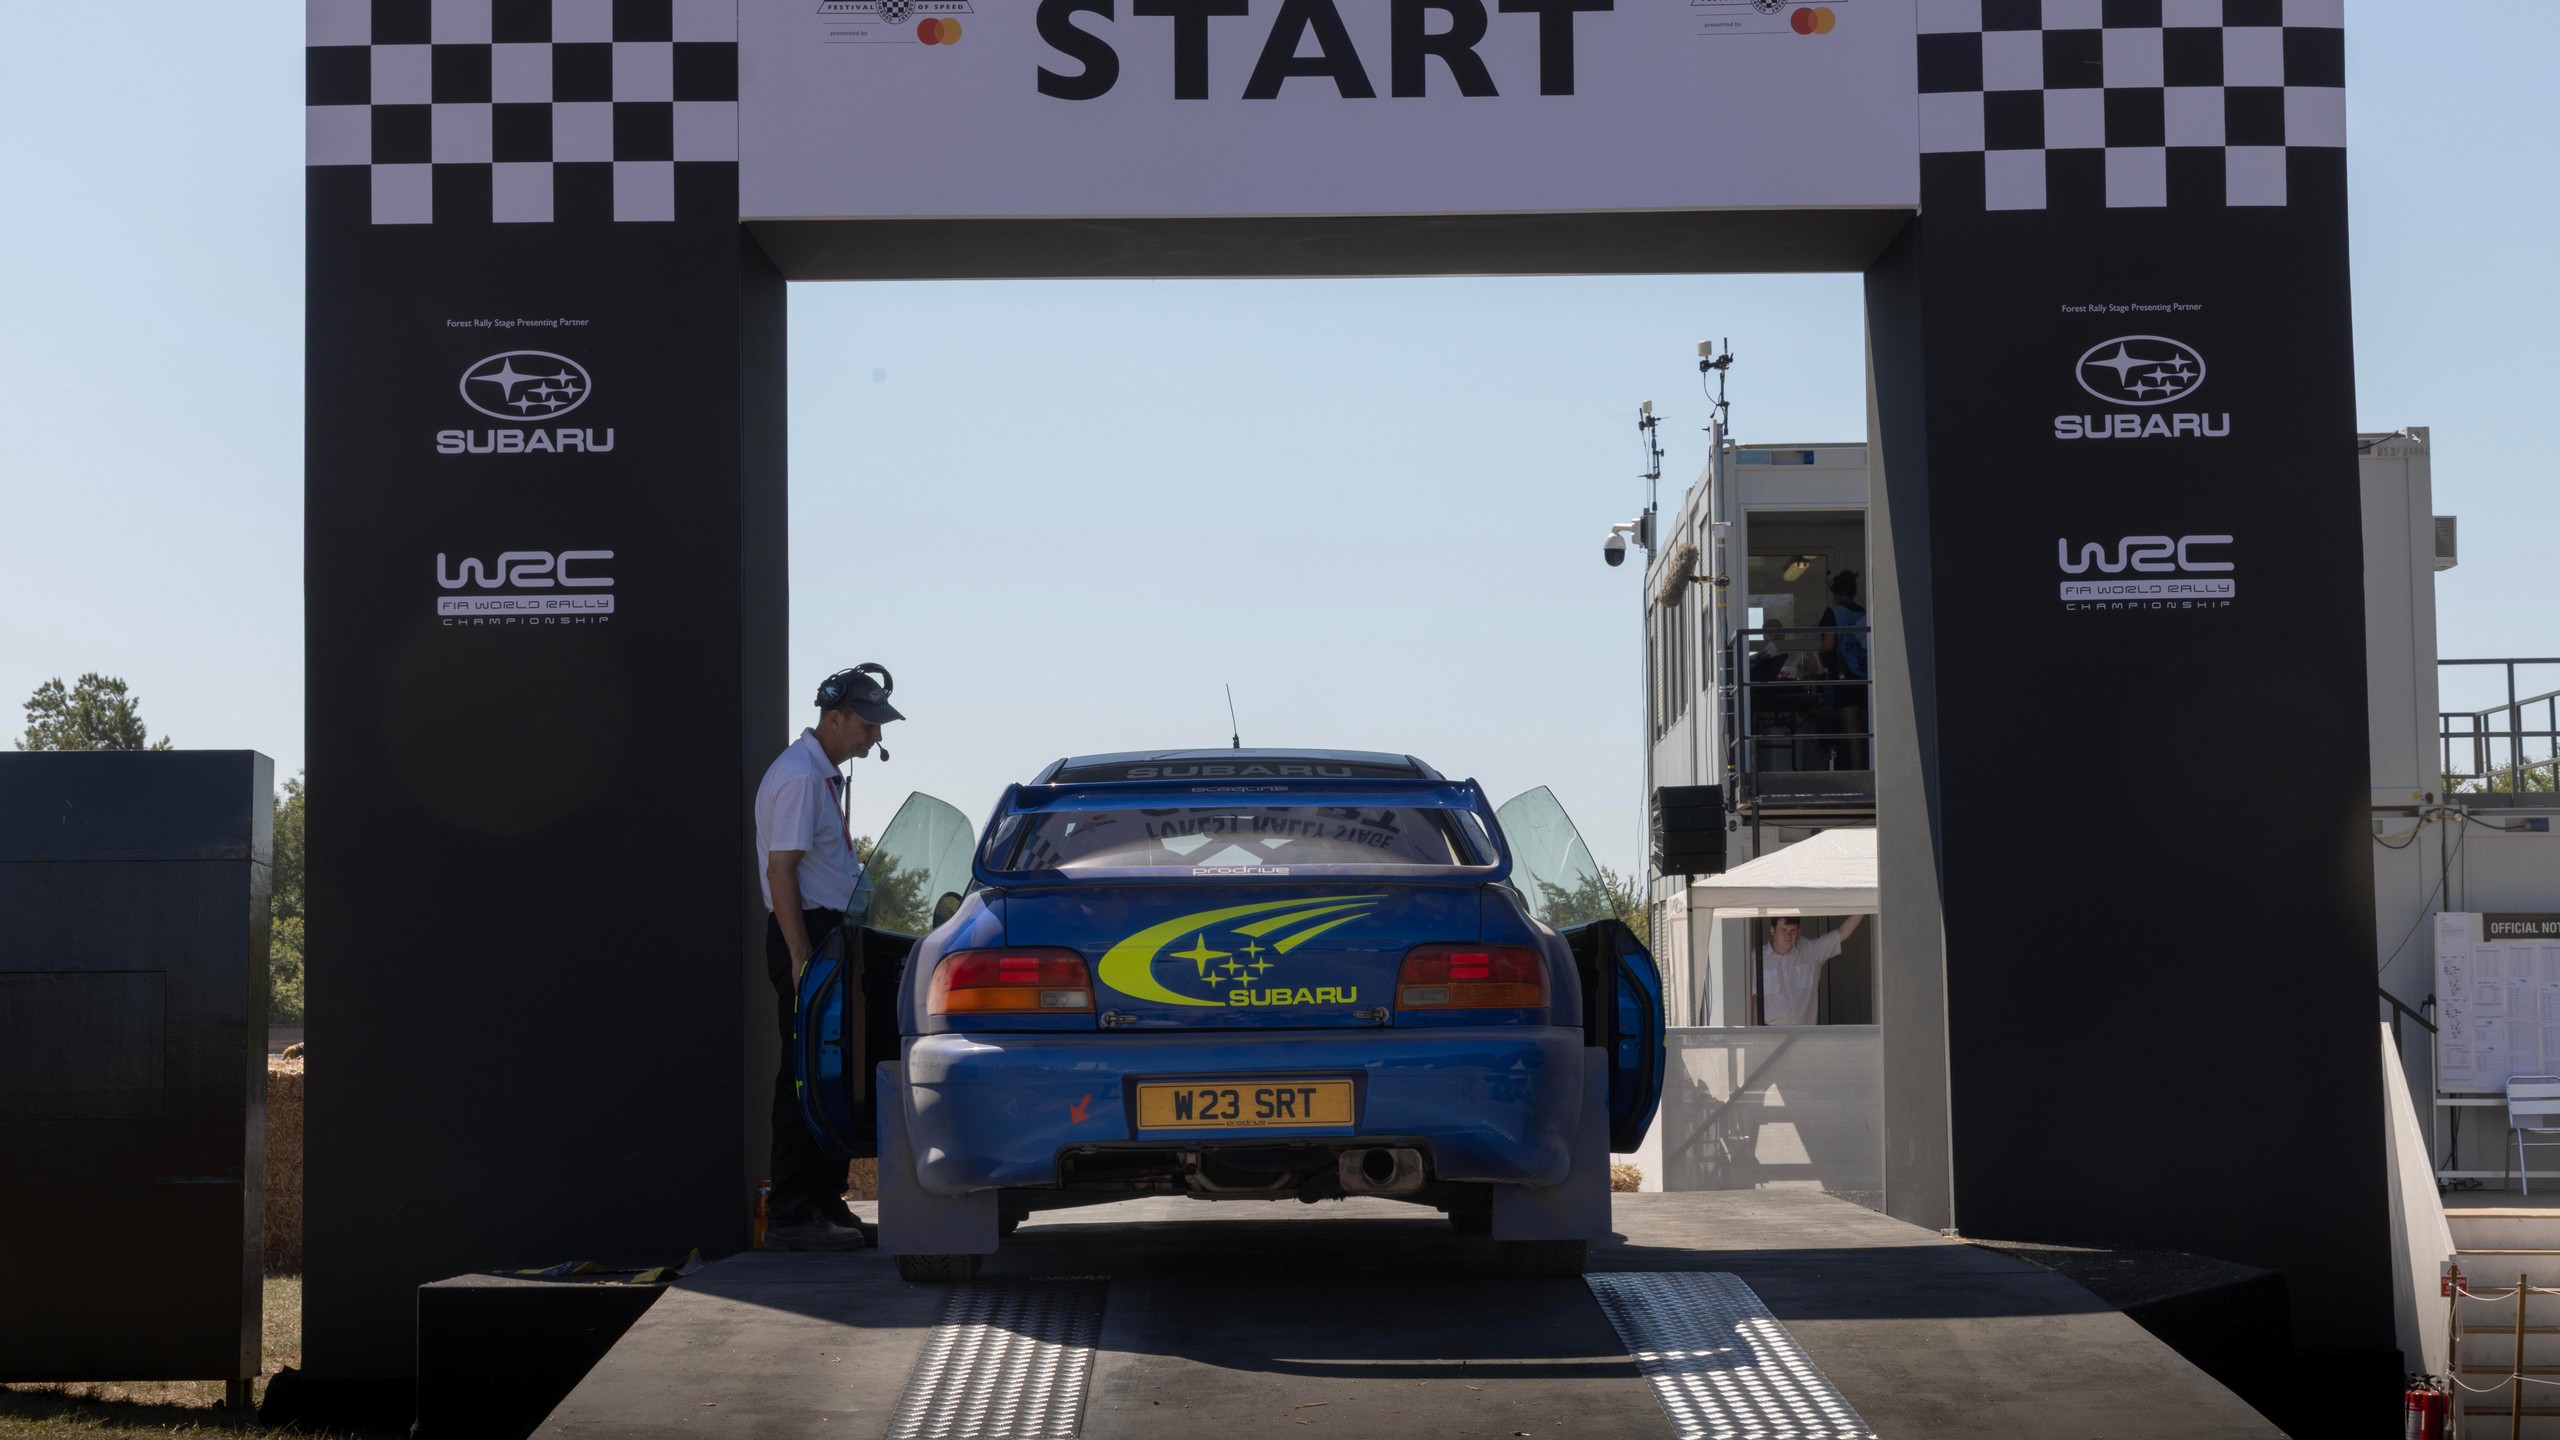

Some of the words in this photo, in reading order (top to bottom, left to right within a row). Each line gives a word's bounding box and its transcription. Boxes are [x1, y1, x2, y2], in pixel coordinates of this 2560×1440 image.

[1704, 20, 1734, 28] presented
[1734, 20, 1742, 28] by
[1036, 0, 1615, 101] START
[2061, 304, 2087, 313] Forest
[2088, 304, 2107, 314] Rally
[2108, 303, 2130, 314] Stage
[2131, 303, 2172, 313] Presenting
[2173, 302, 2203, 311] Partner
[446, 319, 472, 328] Forest
[473, 319, 493, 329] Rally
[494, 318, 516, 329] Stage
[517, 318, 558, 328] Presenting
[559, 317, 590, 326] Partner
[2054, 412, 2231, 440] SUBARU
[436, 427, 615, 454] SUBARU
[2058, 534, 2235, 574] WRC
[436, 550, 615, 589] WRC
[2065, 586, 2092, 595] FIA
[2097, 585, 2162, 594] WORLD
[2167, 584, 2230, 593] RALLY
[443, 601, 469, 610] FIA
[475, 600, 540, 610] WORLD
[546, 600, 609, 609] RALLY
[2066, 601, 2230, 611] CHAMPIONSHIP
[443, 617, 609, 626] CHAMPIONSHIP
[1126, 765, 1353, 779] SUBARU
[1192, 866, 1290, 876] prodrive
[2490, 922, 2539, 934] OFFICIAL
[2541, 921, 2560, 934] NOT
[1229, 986, 1357, 1006] SUBARU
[1174, 1089, 1240, 1121] W23
[1255, 1087, 1317, 1119] SRT
